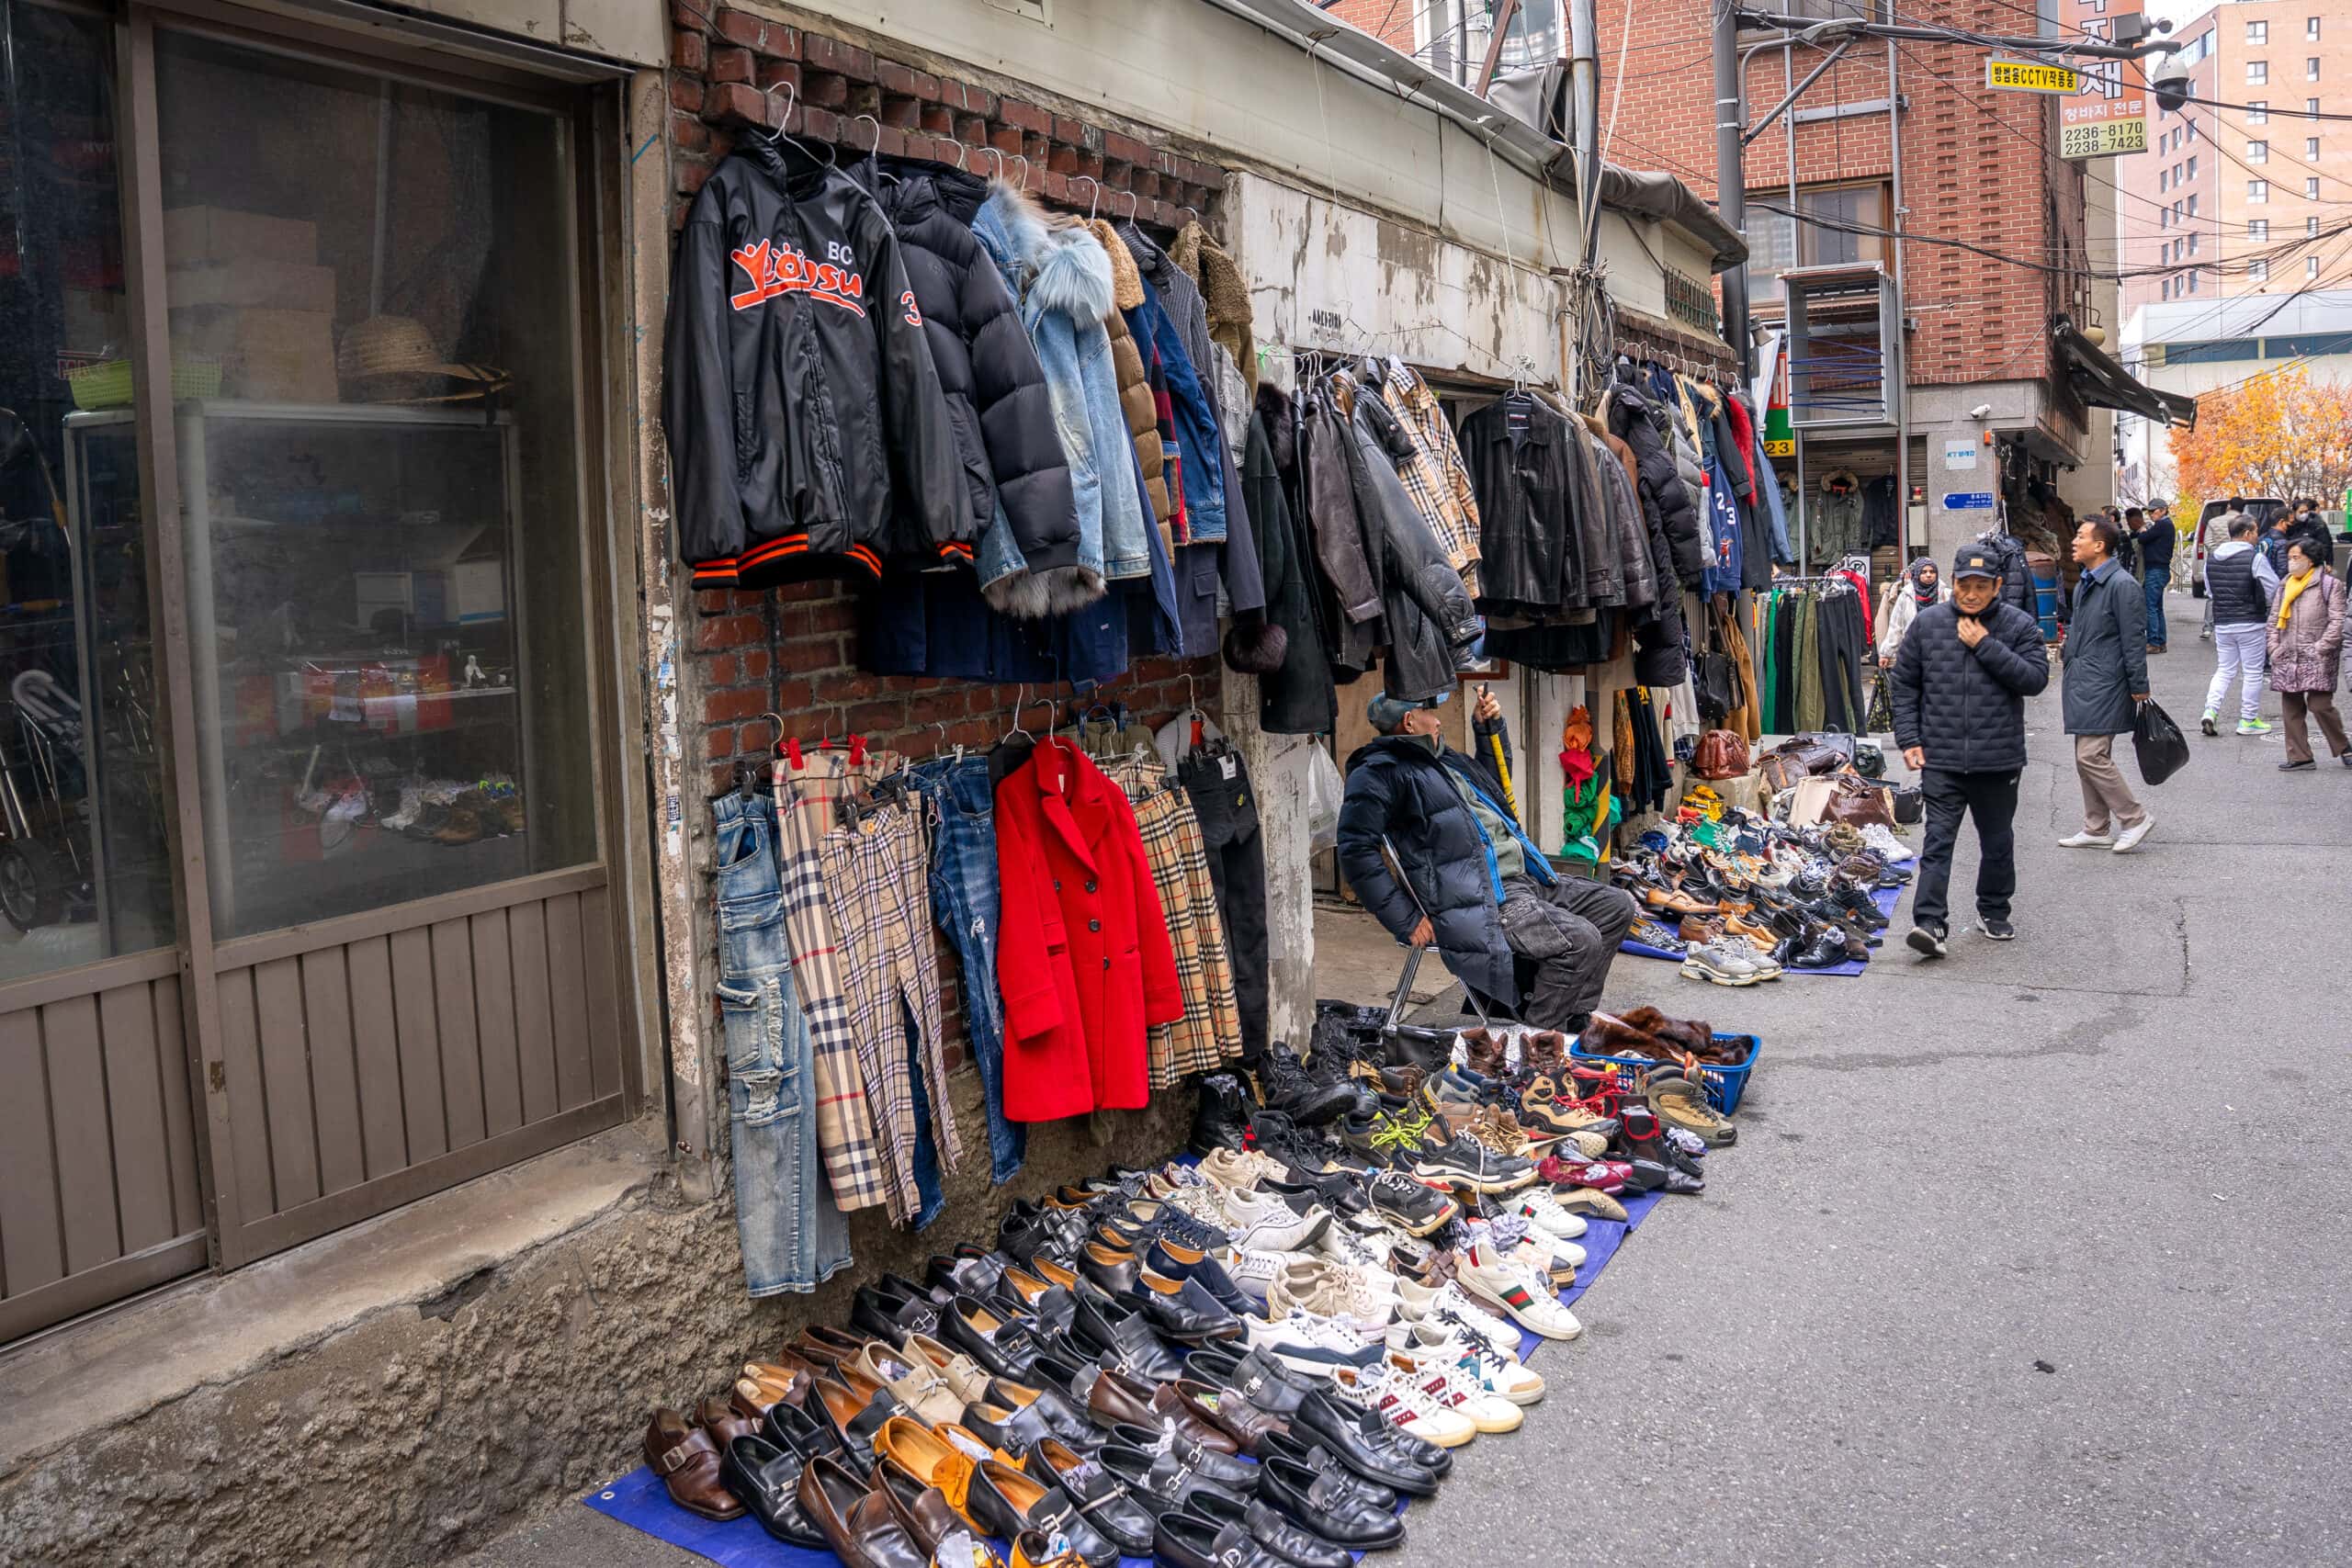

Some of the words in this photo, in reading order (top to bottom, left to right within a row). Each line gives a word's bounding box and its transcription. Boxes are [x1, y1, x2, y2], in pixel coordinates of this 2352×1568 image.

[1994, 65, 2074, 88] 방범용CCTV작동중
[2064, 103, 2108, 122] 청바지
[2113, 99, 2143, 116] 전문
[2065, 121, 2143, 141] 2236-8170
[2065, 136, 2143, 155] 2238-7423
[828, 241, 854, 265] BC
